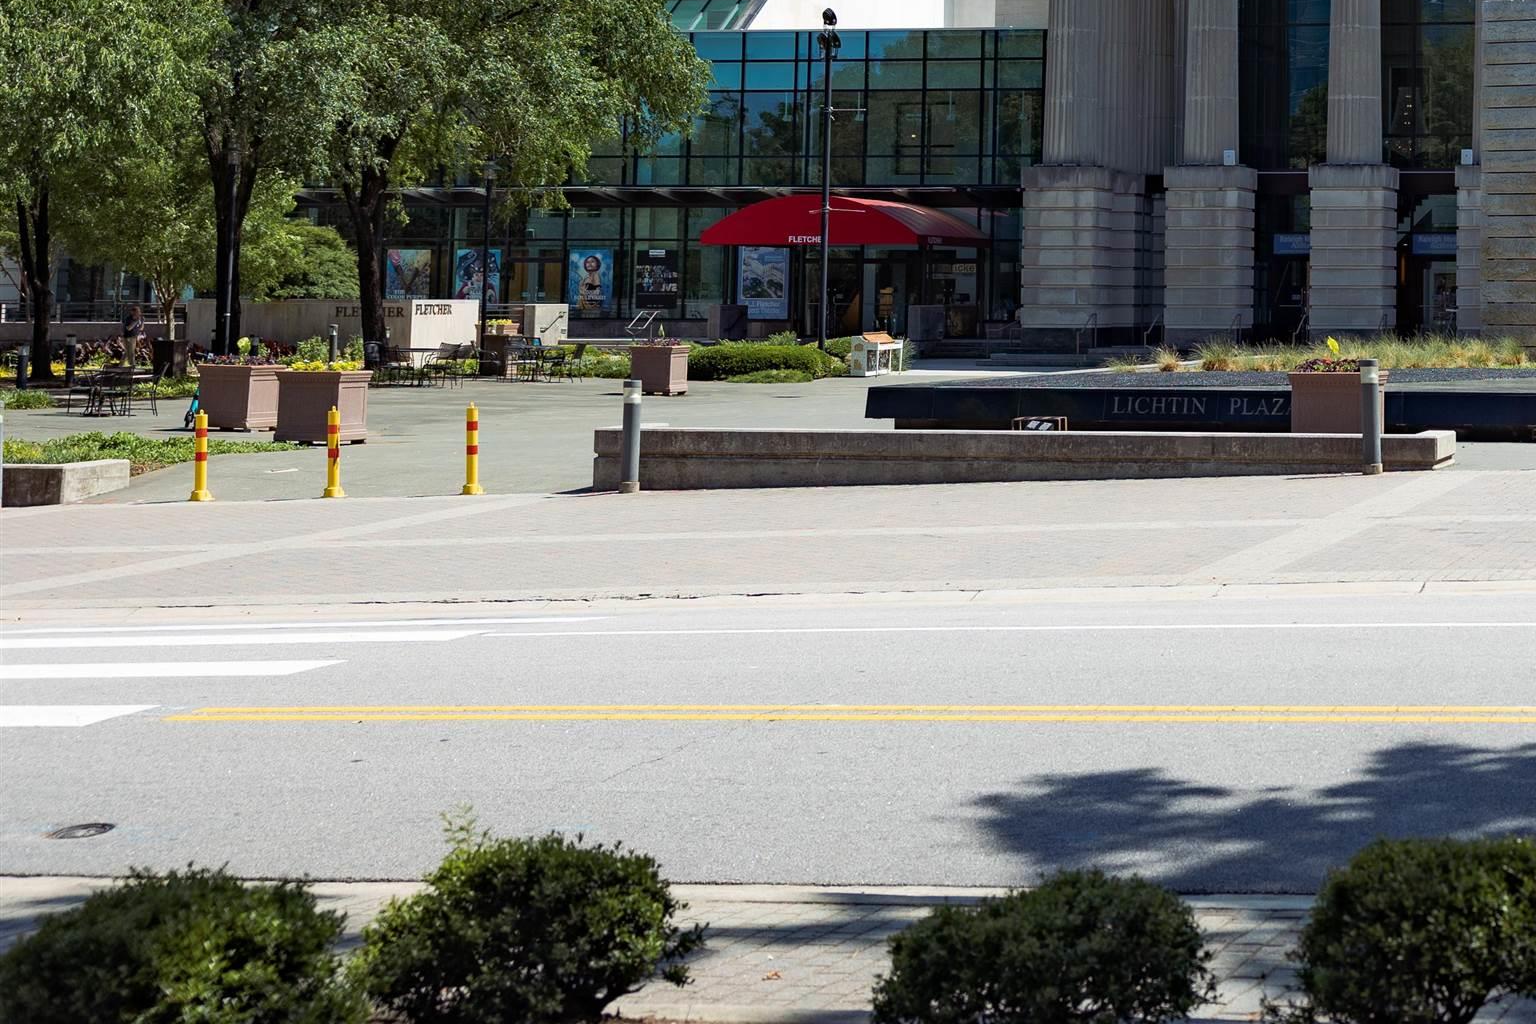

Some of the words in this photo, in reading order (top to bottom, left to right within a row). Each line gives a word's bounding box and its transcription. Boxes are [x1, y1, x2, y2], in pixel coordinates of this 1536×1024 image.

[788, 235, 822, 243] FLETCHE
[335, 306, 404, 317] FLEER
[415, 304, 452, 315] FLETCHER
[1113, 396, 1207, 415] LICHTIN
